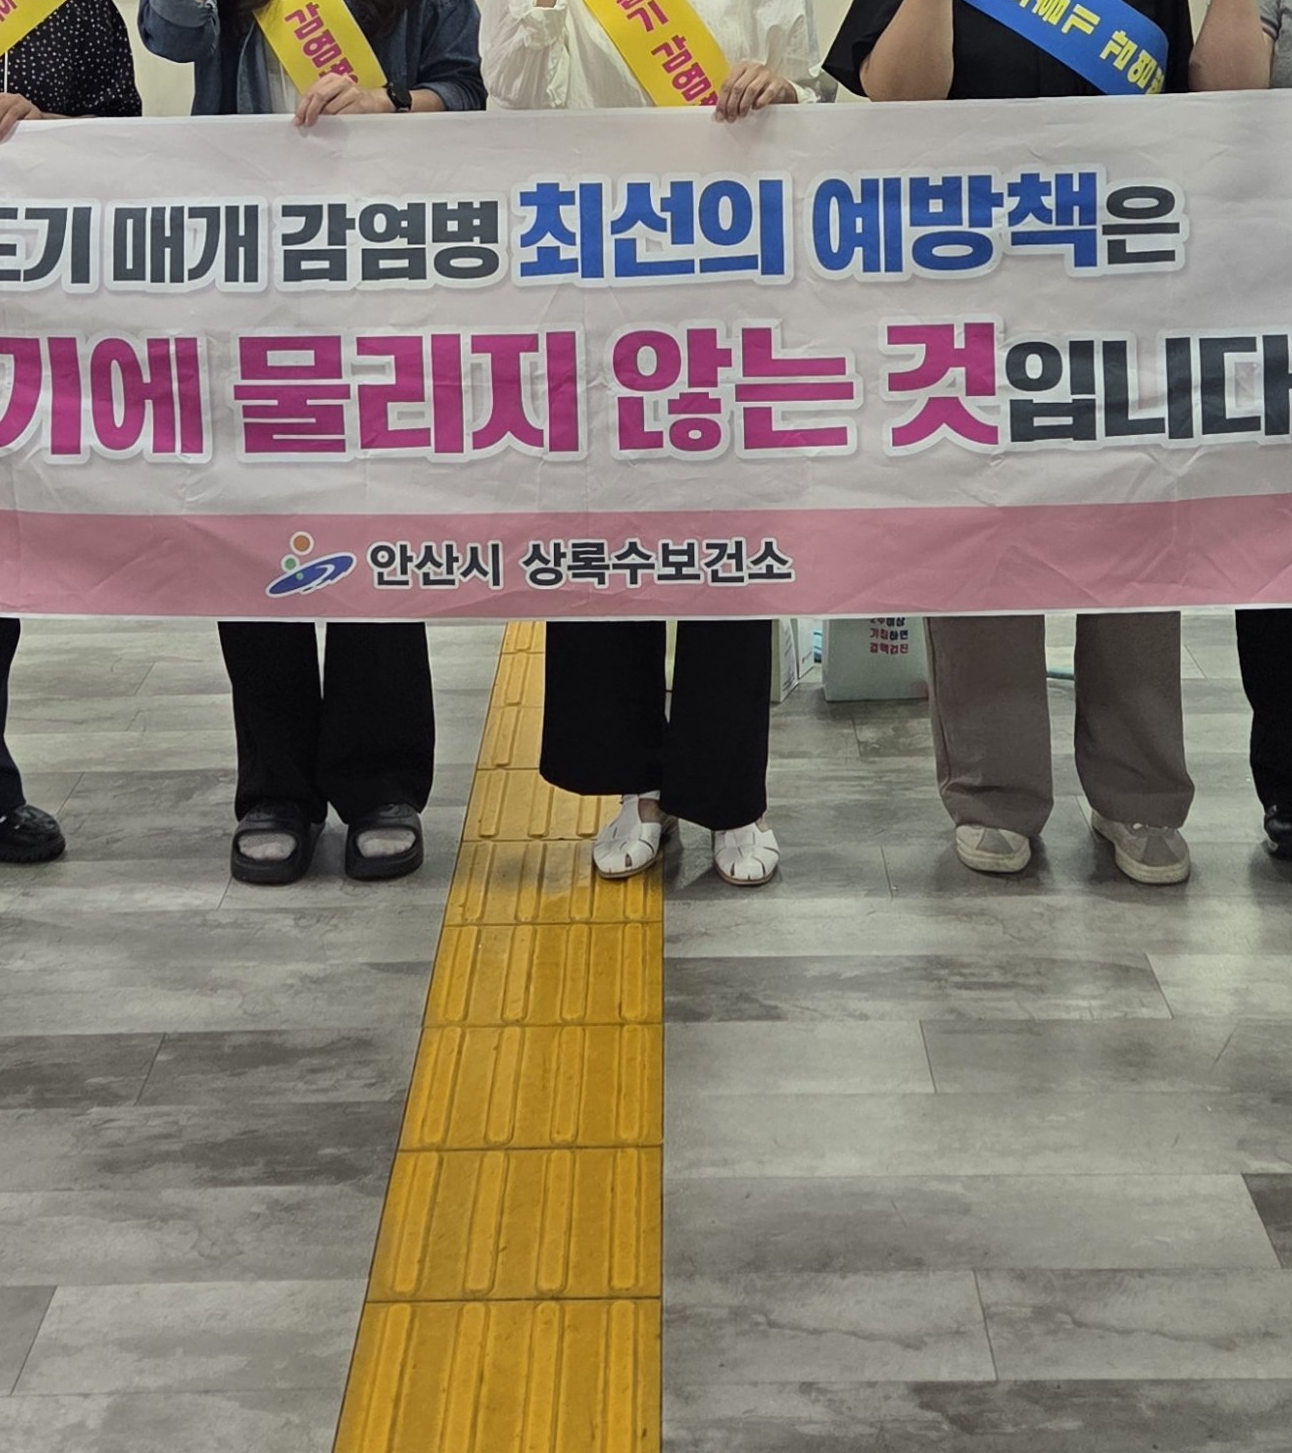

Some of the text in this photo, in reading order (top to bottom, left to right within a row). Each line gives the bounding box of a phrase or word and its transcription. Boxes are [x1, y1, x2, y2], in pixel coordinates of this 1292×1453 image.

[113, 203, 263, 285] 매개
[280, 199, 501, 282] 감염병
[519, 178, 786, 279] 최선의
[811, 171, 1177, 275] 예방책은
[233, 331, 578, 455] 물리지
[614, 325, 855, 452] 않는
[369, 537, 793, 589] 안산시 상록수보건소
[870, 628, 908, 641] 기침하면
